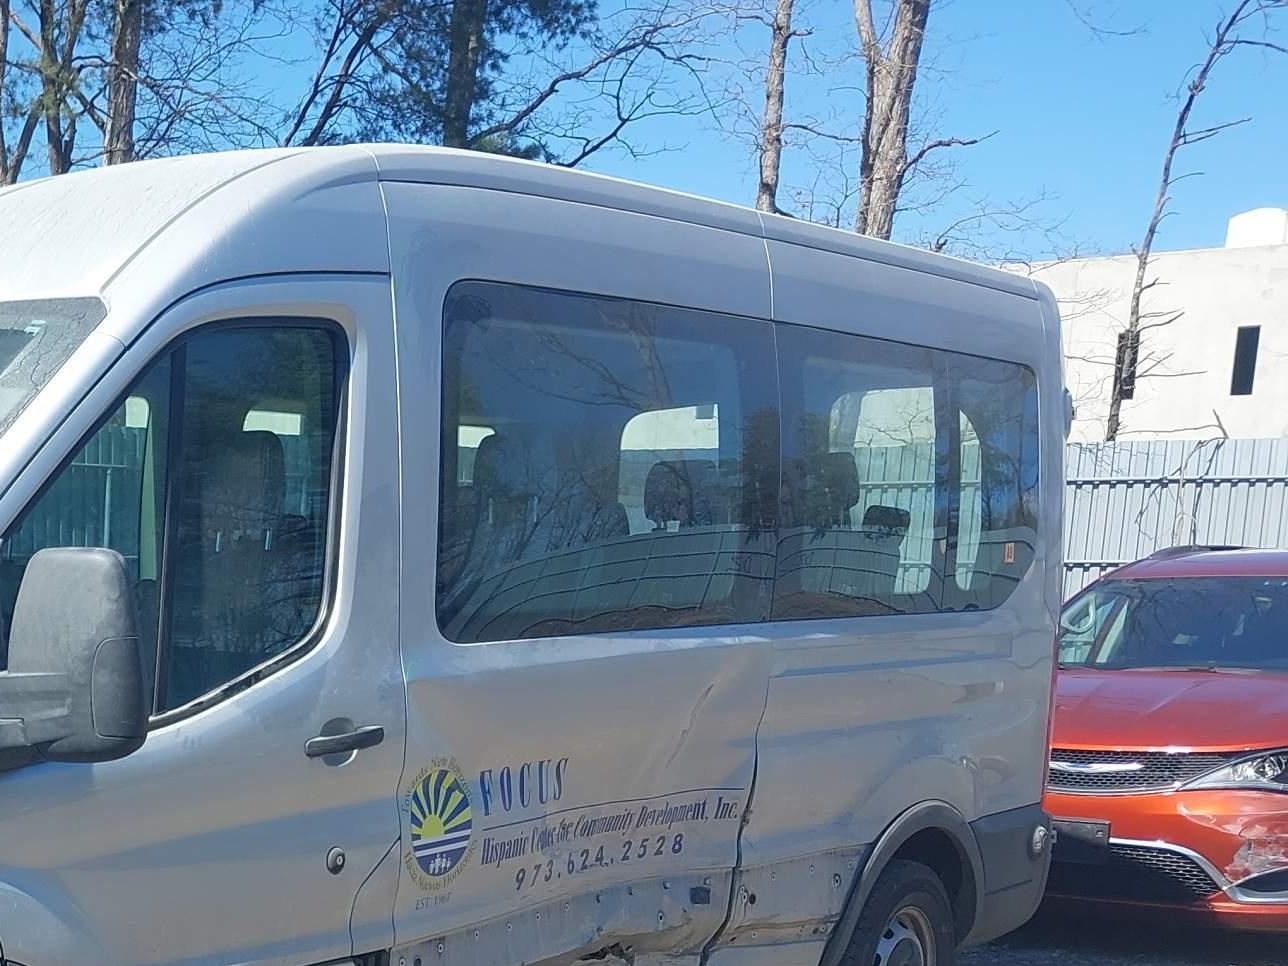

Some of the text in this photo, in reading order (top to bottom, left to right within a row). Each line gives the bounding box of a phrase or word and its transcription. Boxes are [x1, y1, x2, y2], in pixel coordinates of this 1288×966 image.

[479, 757, 569, 816] FOCUS
[480, 831, 529, 868] Hispanic
[556, 817, 574, 843] for
[574, 808, 635, 838] Community
[635, 801, 709, 830] Development,
[713, 796, 738, 820] Inc.
